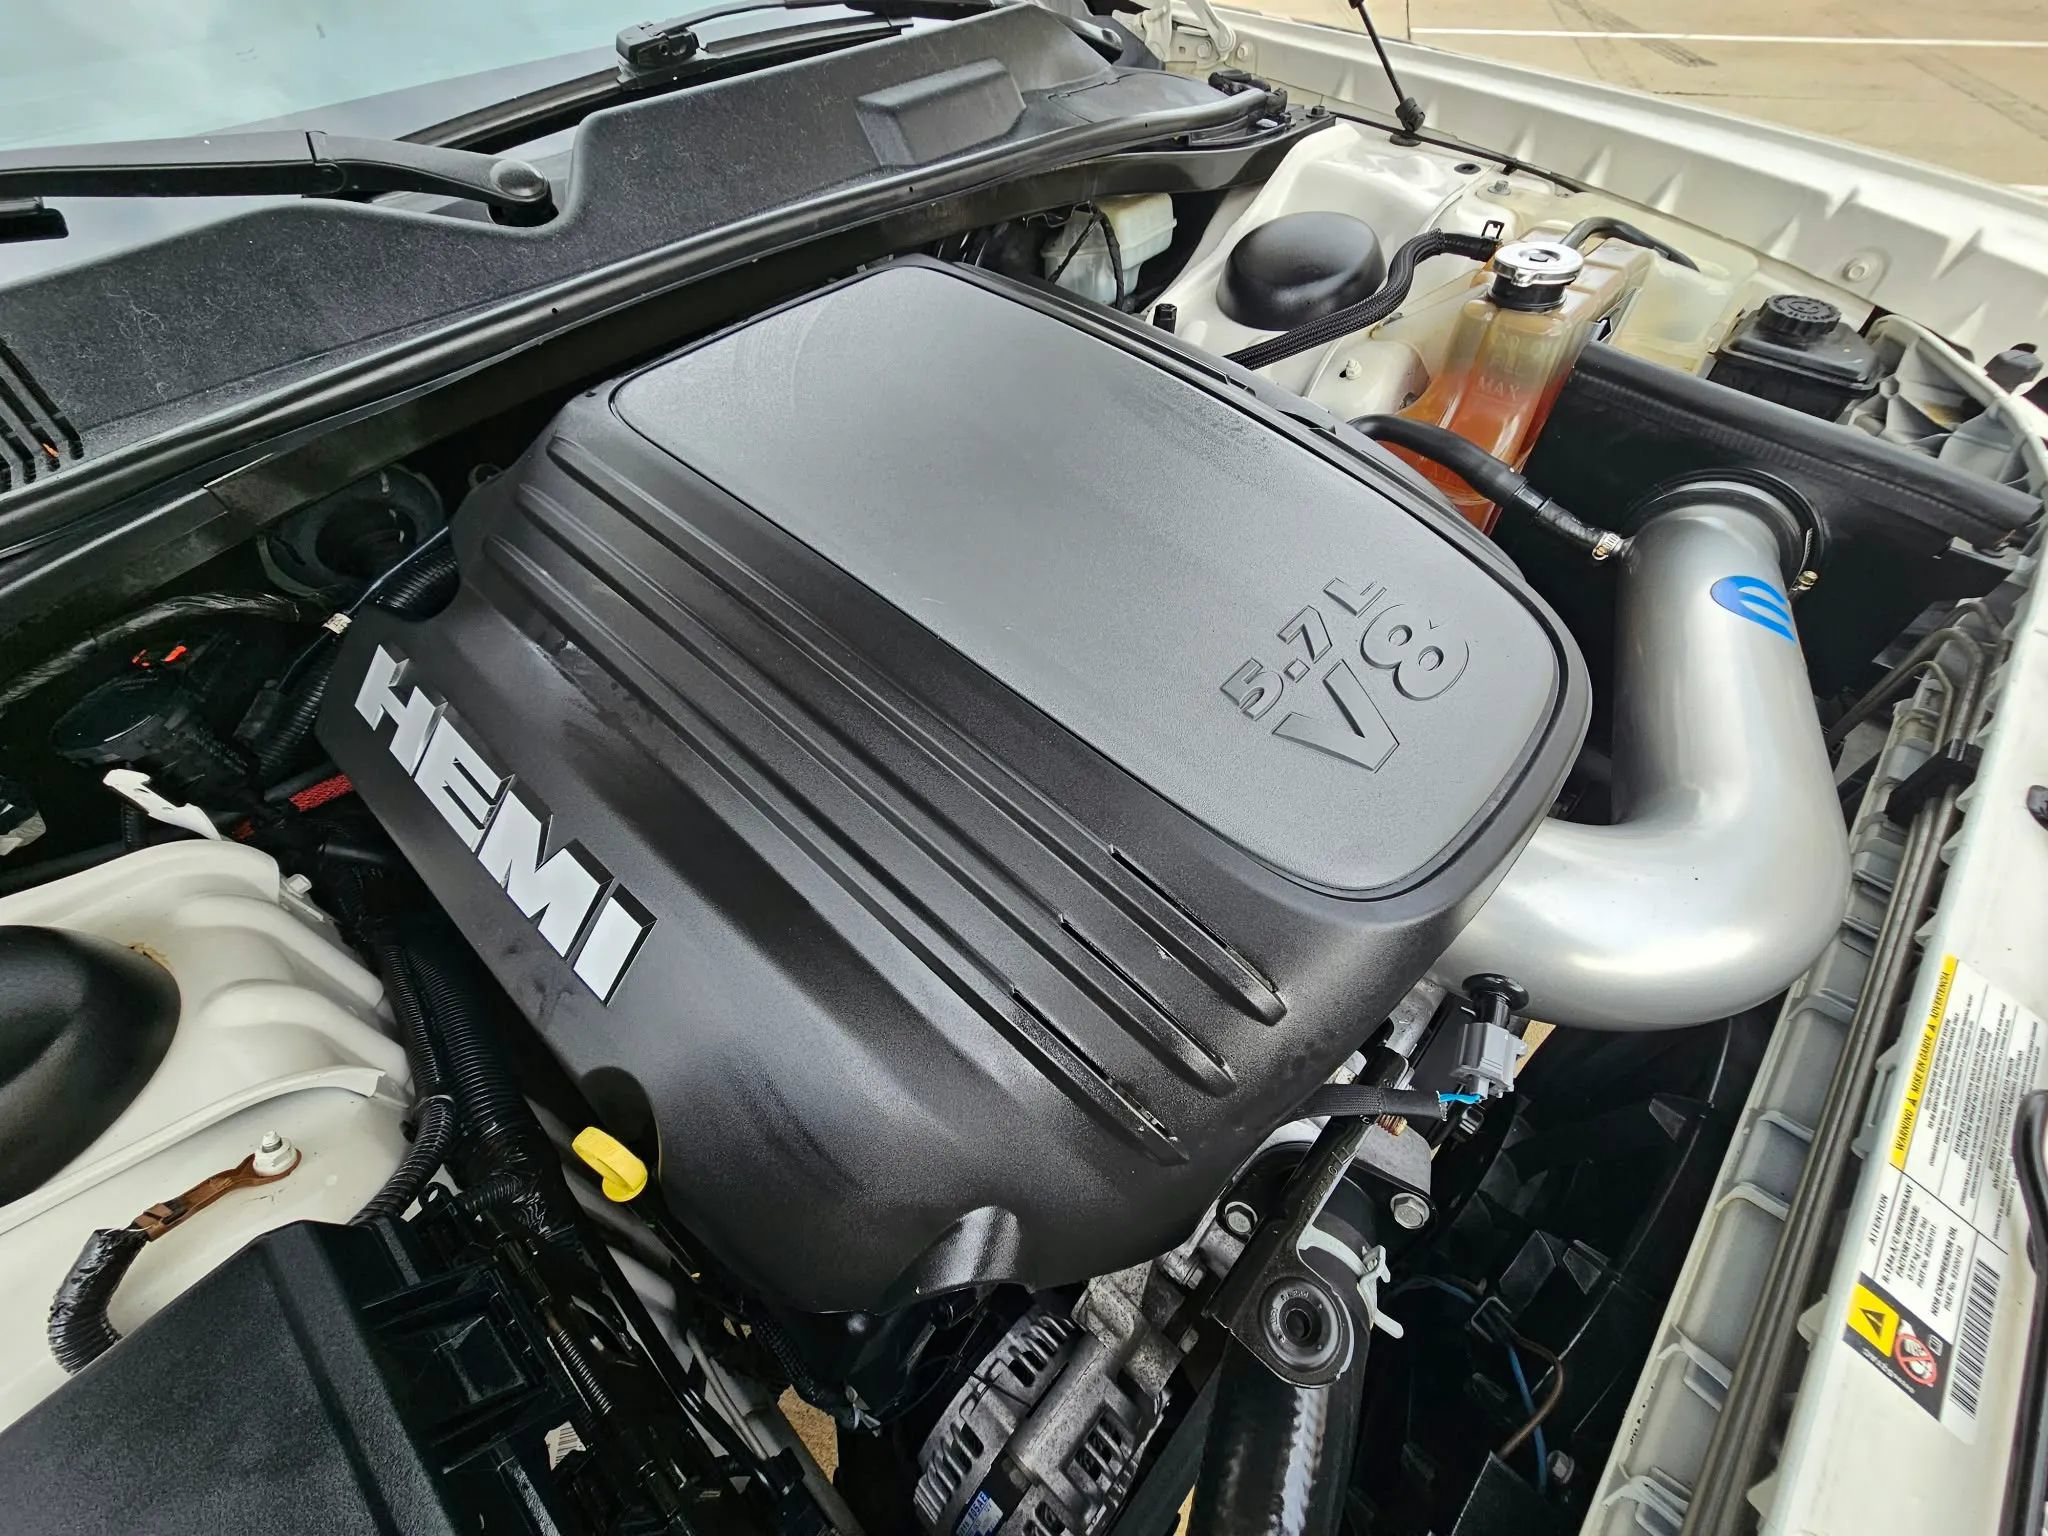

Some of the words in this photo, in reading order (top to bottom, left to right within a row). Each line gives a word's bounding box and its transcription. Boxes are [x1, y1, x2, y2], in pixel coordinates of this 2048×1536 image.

[1271, 604, 1470, 774] V8
[354, 644, 652, 1005] HEMI
[1930, 972, 1950, 1019] ADVERTENCIA
[1916, 1060, 1926, 1073] EN
[1919, 1034, 1932, 1061] GARDE
[1911, 1072, 1923, 1094] MISE
[1896, 1109, 1913, 1151] WARNING
[1869, 1194, 1888, 1245] ATTENTION
[1894, 1184, 1913, 1236] REFRIGERANT
[1889, 1236, 1900, 1255] A/C
[1896, 1240, 1910, 1278] FACTORY
[1936, 1240, 1953, 1297] COMPRESSOR
[1948, 1226, 1958, 1241] OIL
